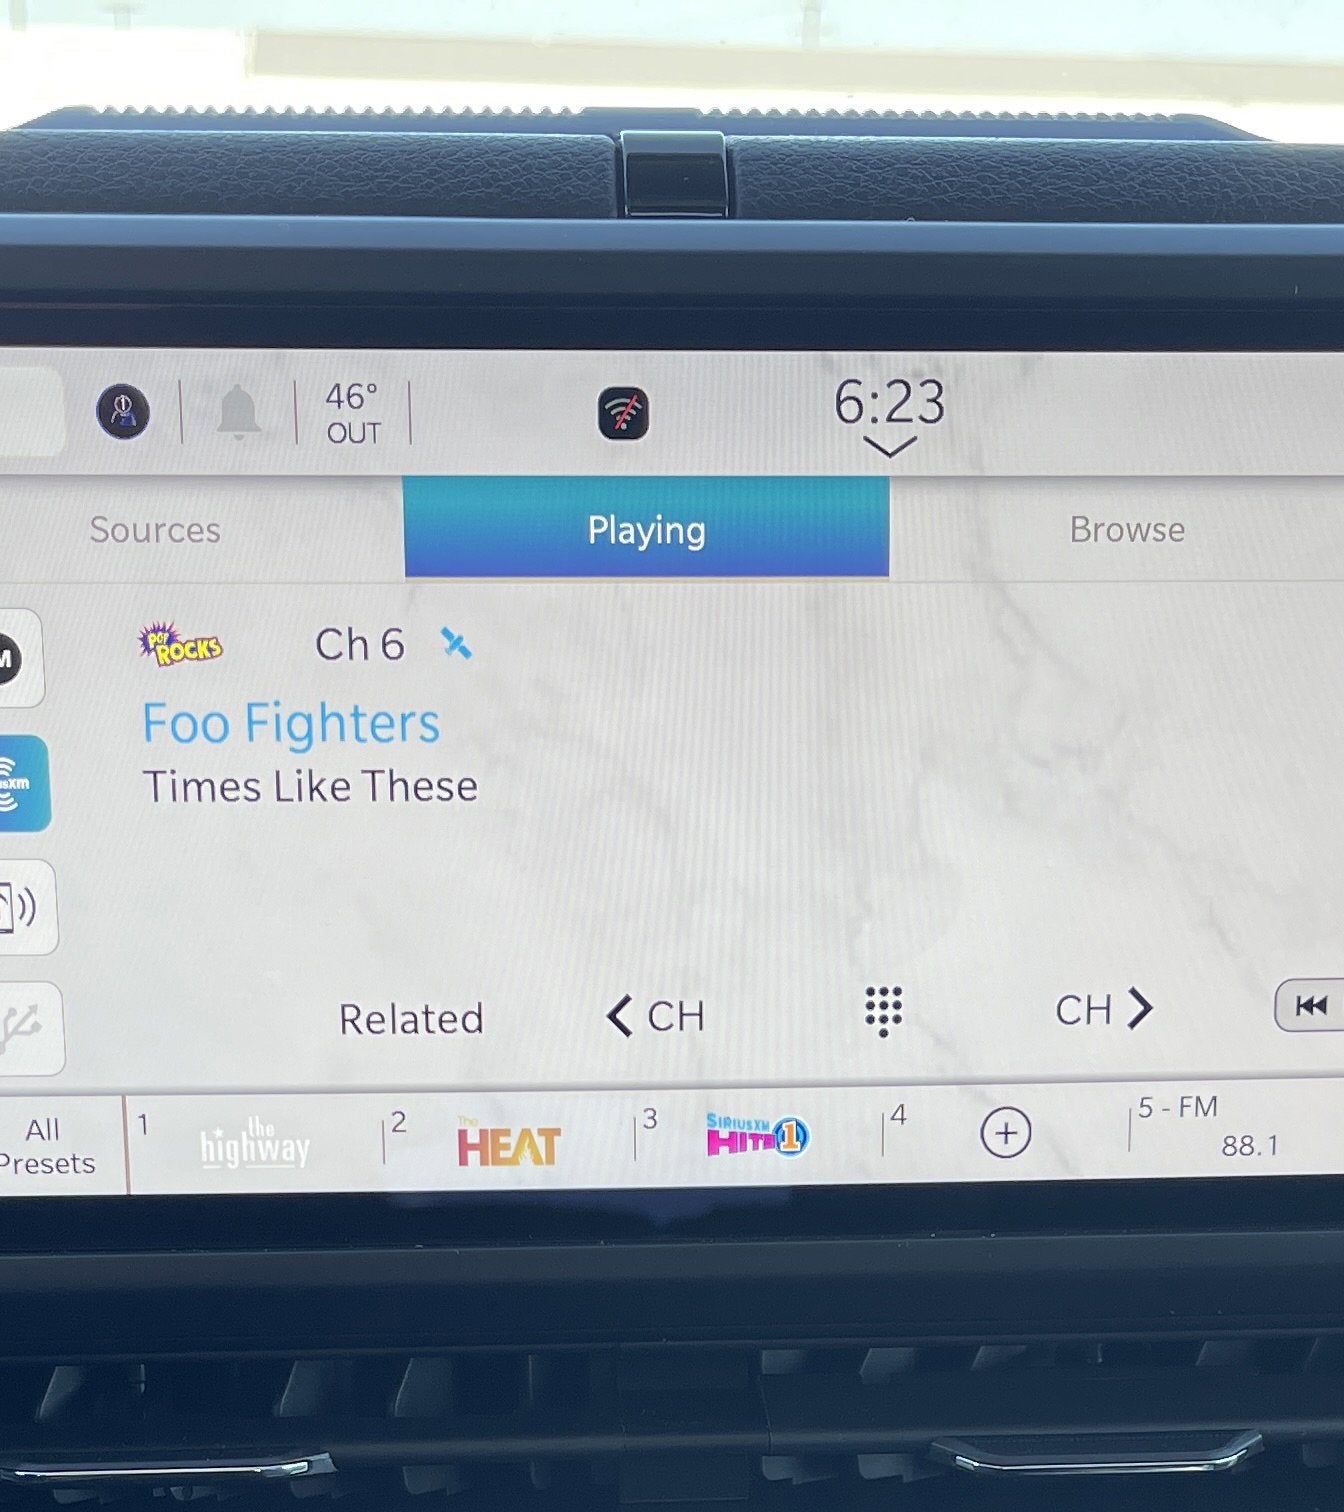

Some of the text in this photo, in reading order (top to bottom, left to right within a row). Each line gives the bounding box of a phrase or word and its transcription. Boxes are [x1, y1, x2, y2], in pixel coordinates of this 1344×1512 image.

[835, 378, 946, 425] 6:23
[326, 422, 382, 445] OUT
[89, 514, 222, 545] Sources
[588, 515, 707, 551] Playing
[1070, 515, 1186, 544] Browse
[156, 637, 222, 666] ROCKS
[314, 627, 406, 661] Ch 6
[144, 701, 441, 754] Foo Fighters
[143, 769, 479, 804] Times Like These
[339, 1001, 485, 1036] Related
[647, 1000, 705, 1034] CH
[1056, 994, 1112, 1026] CH
[457, 1115, 479, 1128] The
[643, 1107, 658, 1130] 3
[889, 1103, 908, 1126] 4
[1138, 1097, 1154, 1119] 5
[1180, 1096, 1219, 1118] FM
[25, 1118, 60, 1142] All
[137, 1113, 149, 1136] 1
[248, 1115, 275, 1137] the
[391, 1111, 407, 1135] 2
[779, 1118, 801, 1153] 1
[200, 1127, 311, 1169] highway
[457, 1127, 562, 1167] HEAT
[1222, 1134, 1279, 1158] 88.1
